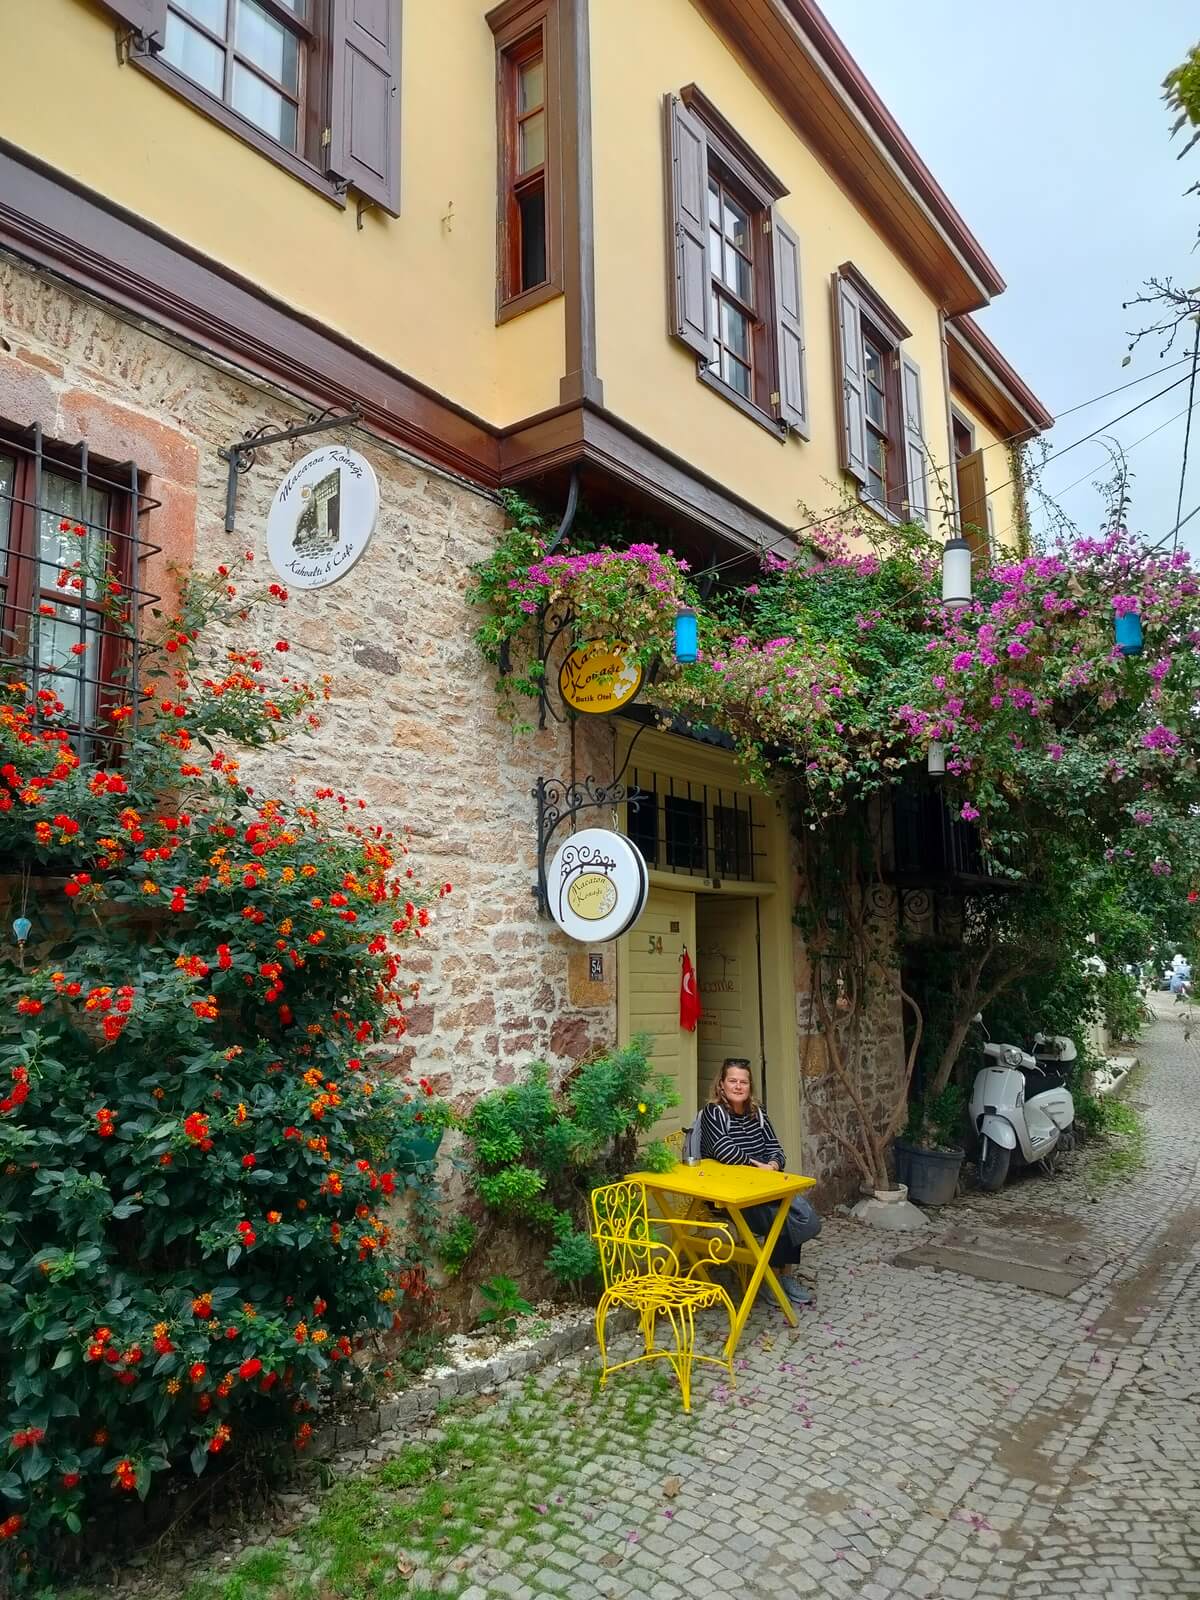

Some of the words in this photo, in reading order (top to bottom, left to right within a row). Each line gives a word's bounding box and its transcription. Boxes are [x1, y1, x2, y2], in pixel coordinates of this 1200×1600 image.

[279, 456, 325, 502] Macaron
[647, 935, 664, 955] 54
[591, 960, 601, 973] 54
